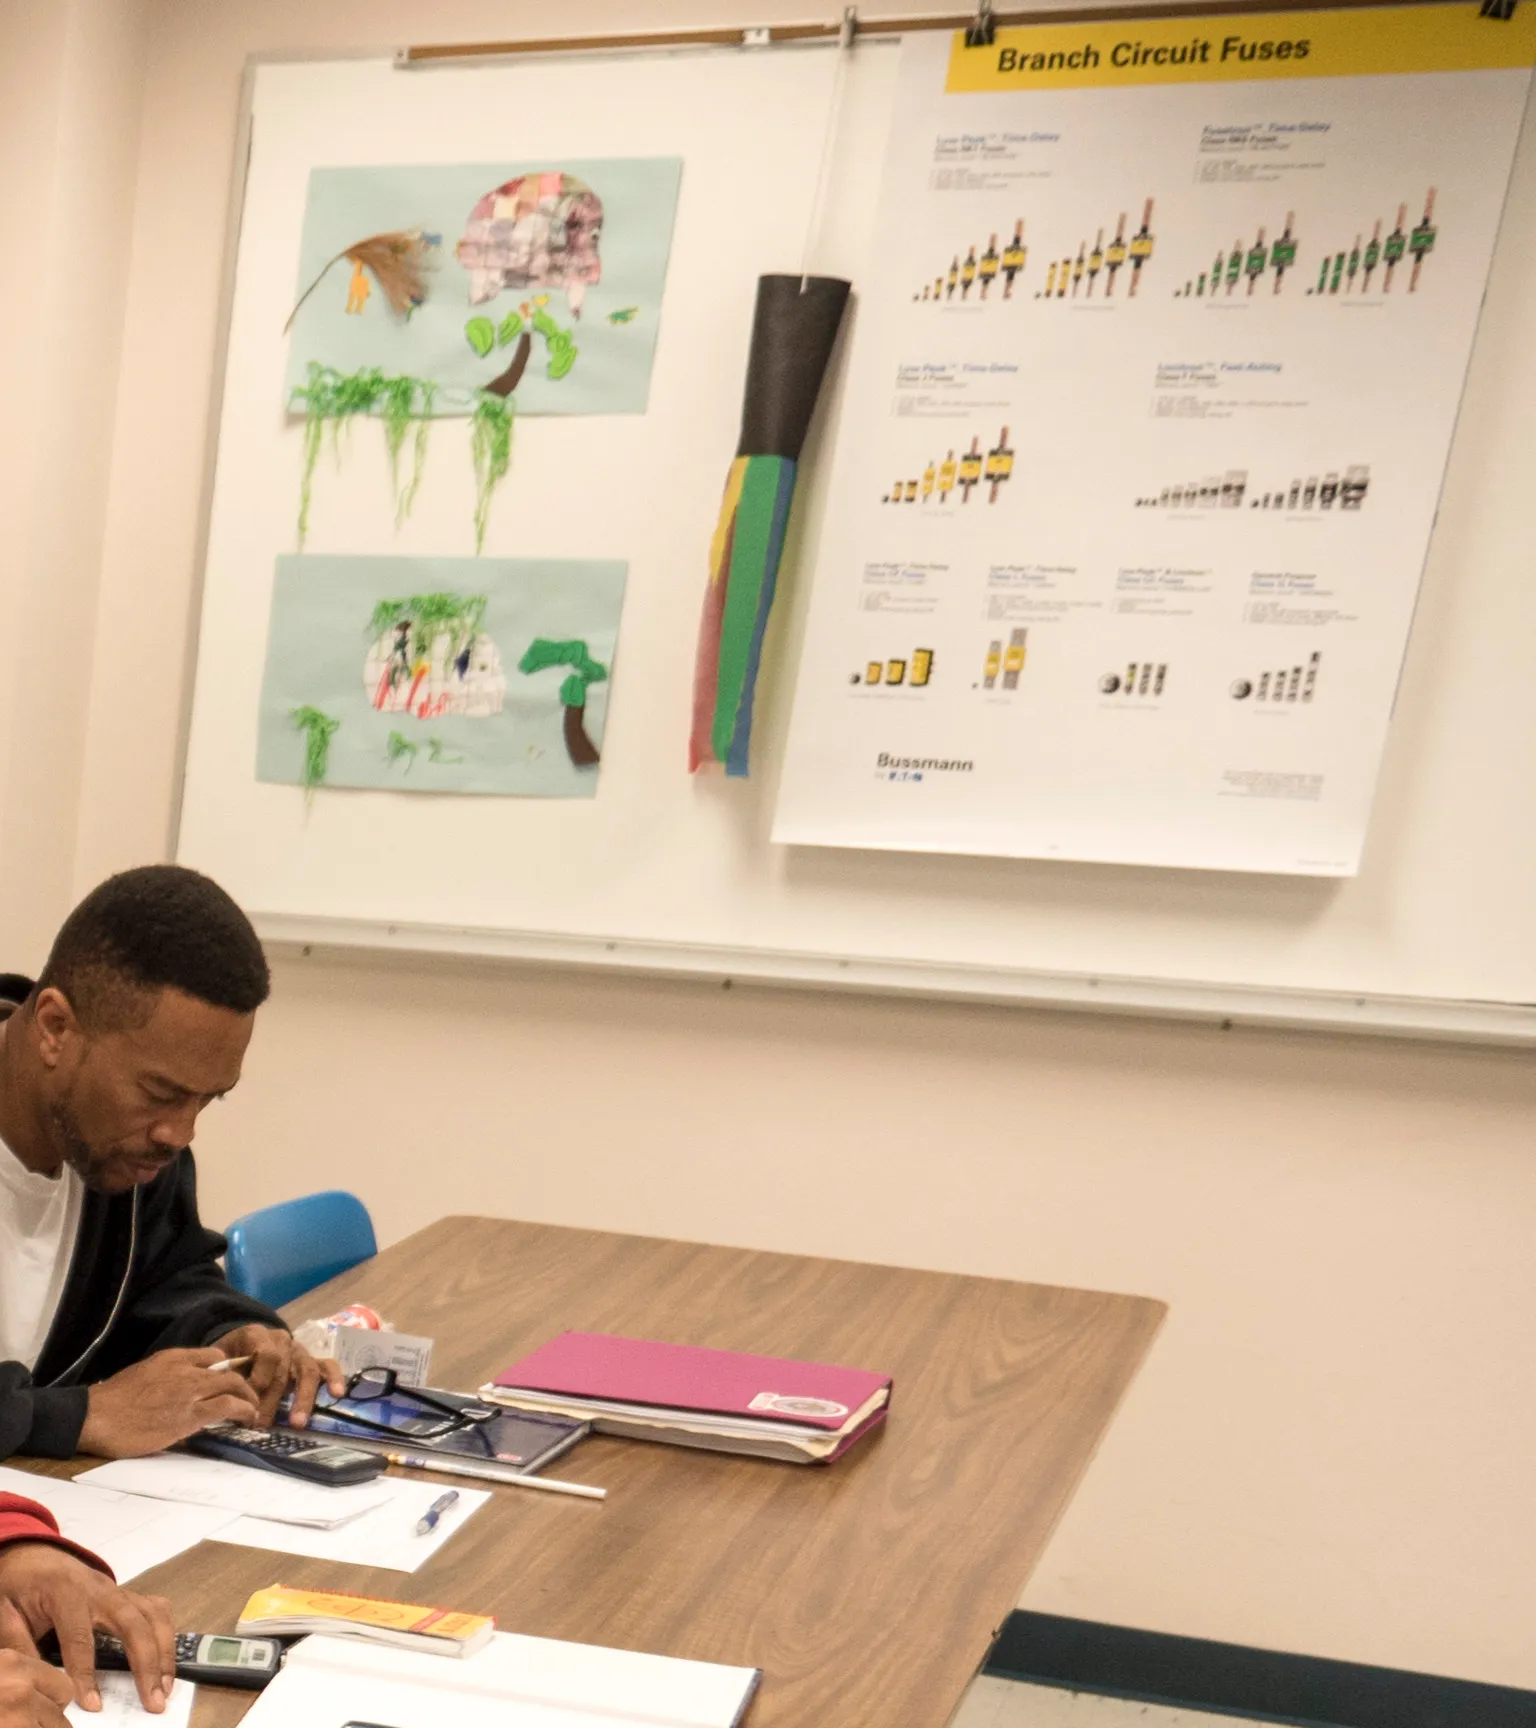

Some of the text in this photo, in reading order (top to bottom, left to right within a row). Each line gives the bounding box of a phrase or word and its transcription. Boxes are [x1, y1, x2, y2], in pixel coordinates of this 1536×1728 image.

[998, 36, 1311, 72] Branch Circuit Fuses
[877, 752, 973, 772] Bussmann
